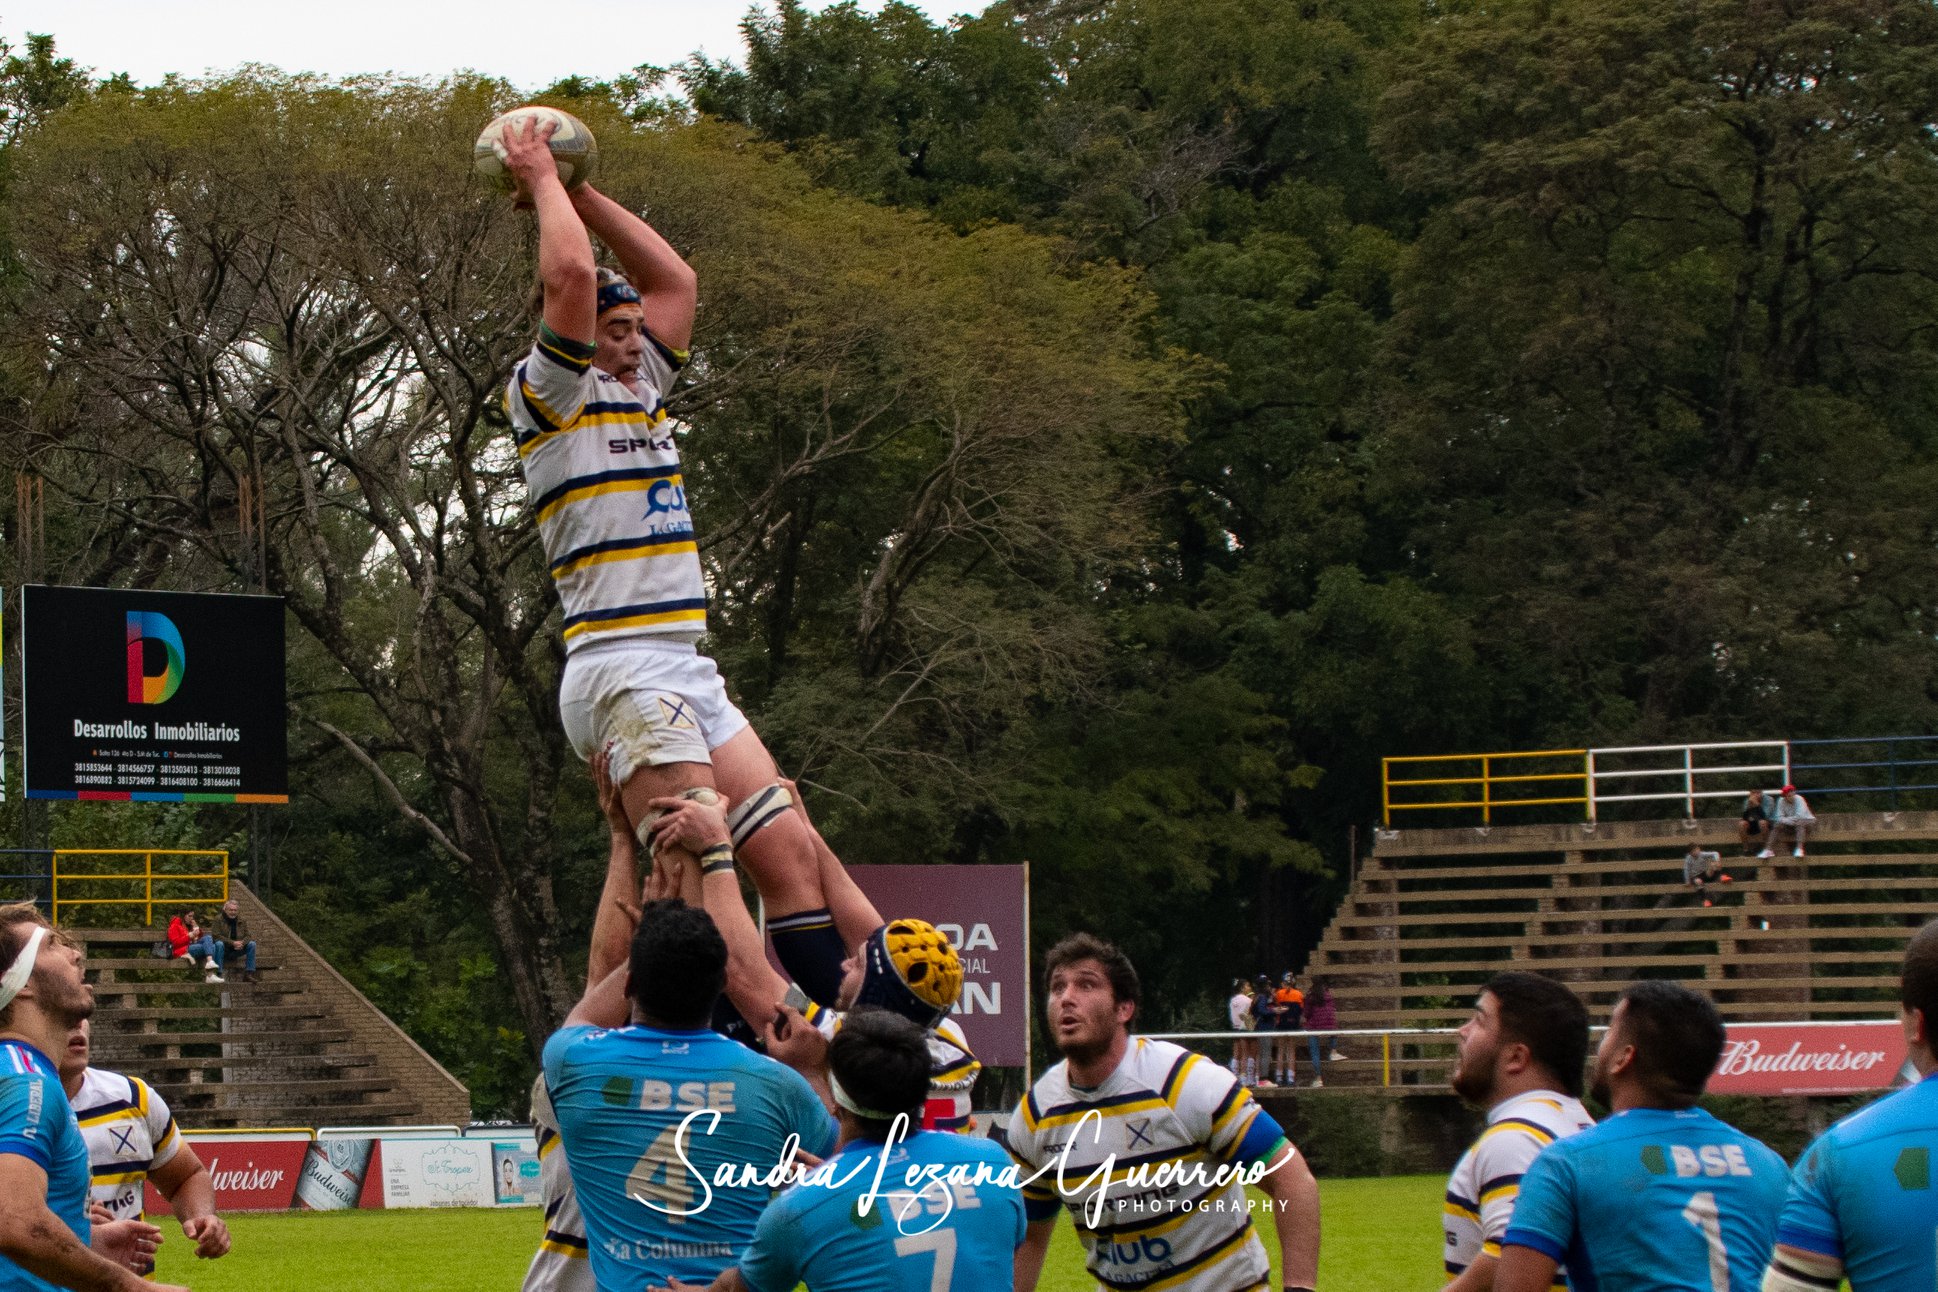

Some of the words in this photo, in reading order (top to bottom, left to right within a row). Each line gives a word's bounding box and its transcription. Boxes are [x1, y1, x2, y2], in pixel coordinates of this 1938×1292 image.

[74, 719, 148, 739] Desarrollos
[154, 721, 241, 742] Inmobiliarios
[1717, 1039, 1886, 1076] Budweiser
[639, 1079, 736, 1113] BSE
[209, 1158, 284, 1191] weiser
[626, 1125, 694, 1225] 4
[1671, 1145, 1752, 1178] BSE
[887, 1176, 981, 1222] BSE
[894, 1228, 957, 1292] 7
[1681, 1191, 1730, 1292] 1
